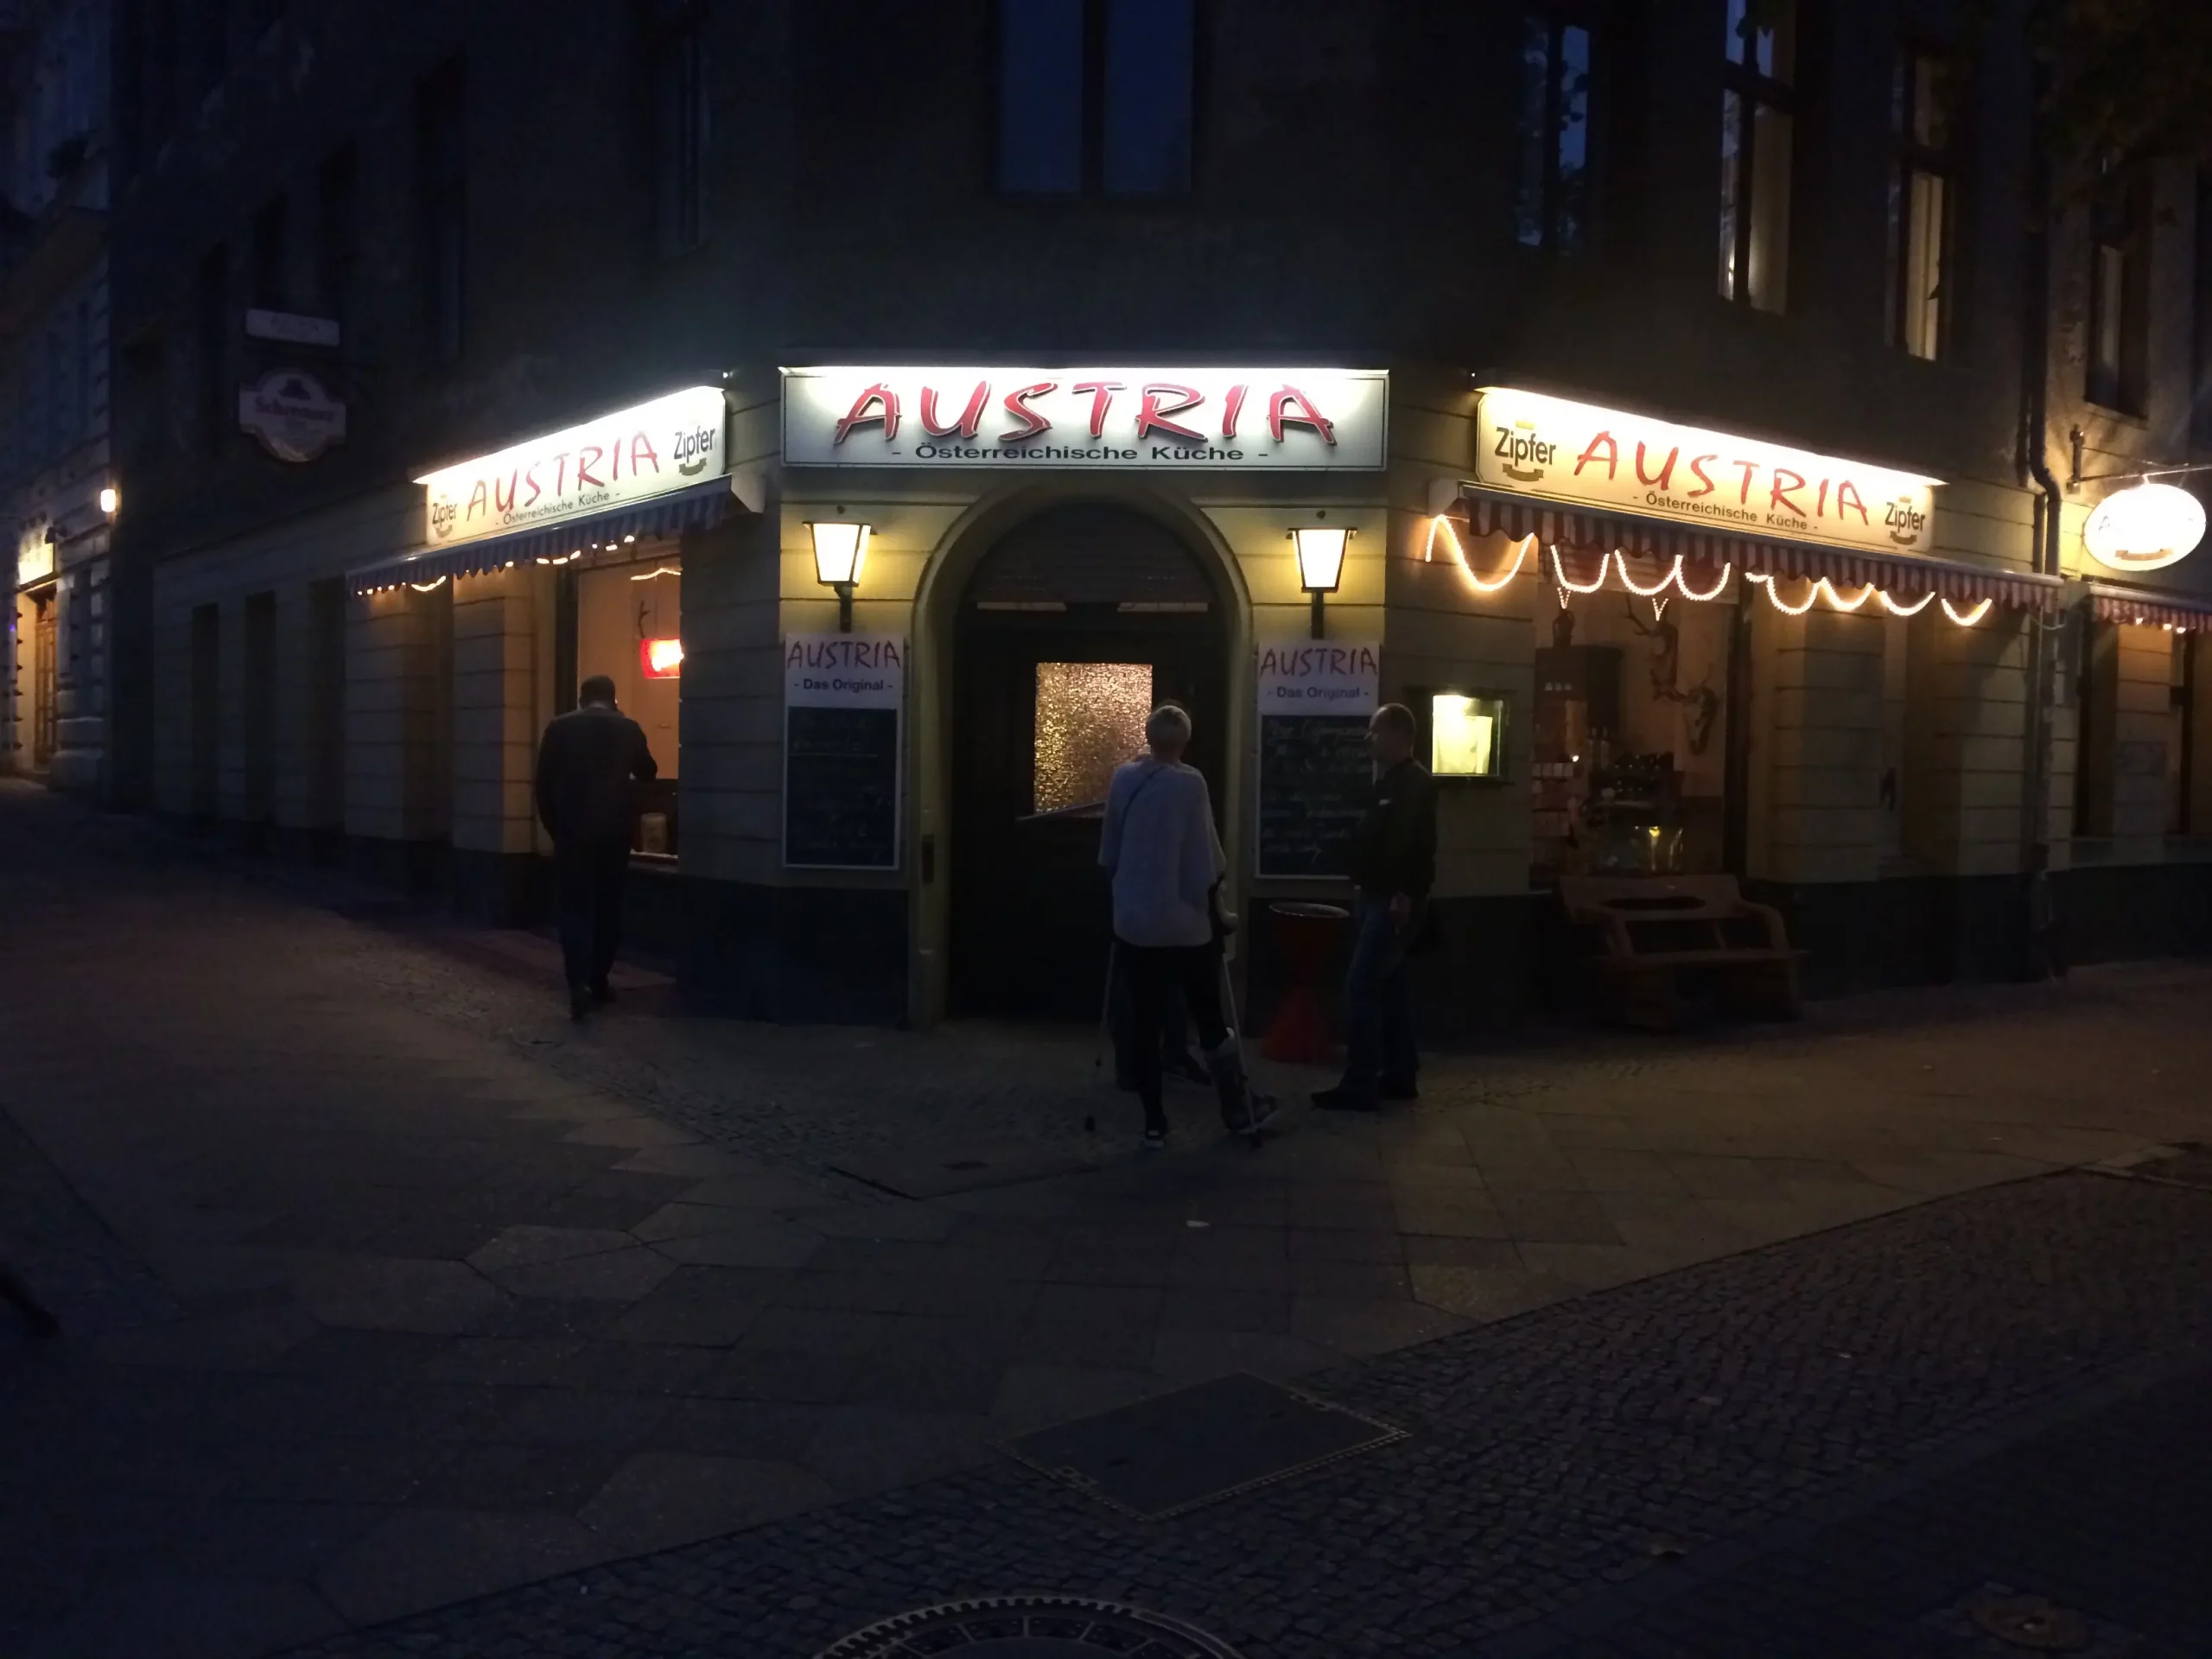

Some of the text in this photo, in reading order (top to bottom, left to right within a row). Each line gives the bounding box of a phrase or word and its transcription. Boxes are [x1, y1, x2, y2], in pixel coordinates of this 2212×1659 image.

[834, 380, 1338, 446] AUSTRIA
[674, 425, 715, 463] Zipfer
[916, 442, 1137, 460] Österreichische
[1152, 446, 1243, 460] Küche
[1495, 426, 1556, 467] Zipfer
[467, 431, 659, 521] AUSTRIA
[1573, 430, 1869, 525] AUSTRIA
[432, 499, 458, 529] Zipfer
[503, 499, 574, 525] Österreichische
[578, 491, 610, 506] Küche
[1646, 490, 1758, 522] Österreichische
[1766, 512, 1808, 530] Küche
[1885, 501, 1926, 533] Zipfer
[787, 640, 900, 669] AUSTRIA
[1260, 647, 1377, 677] AUSTRIA
[804, 678, 830, 690] Das
[833, 678, 884, 692] Original
[1277, 686, 1302, 698] Das
[1307, 686, 1359, 702] Original
